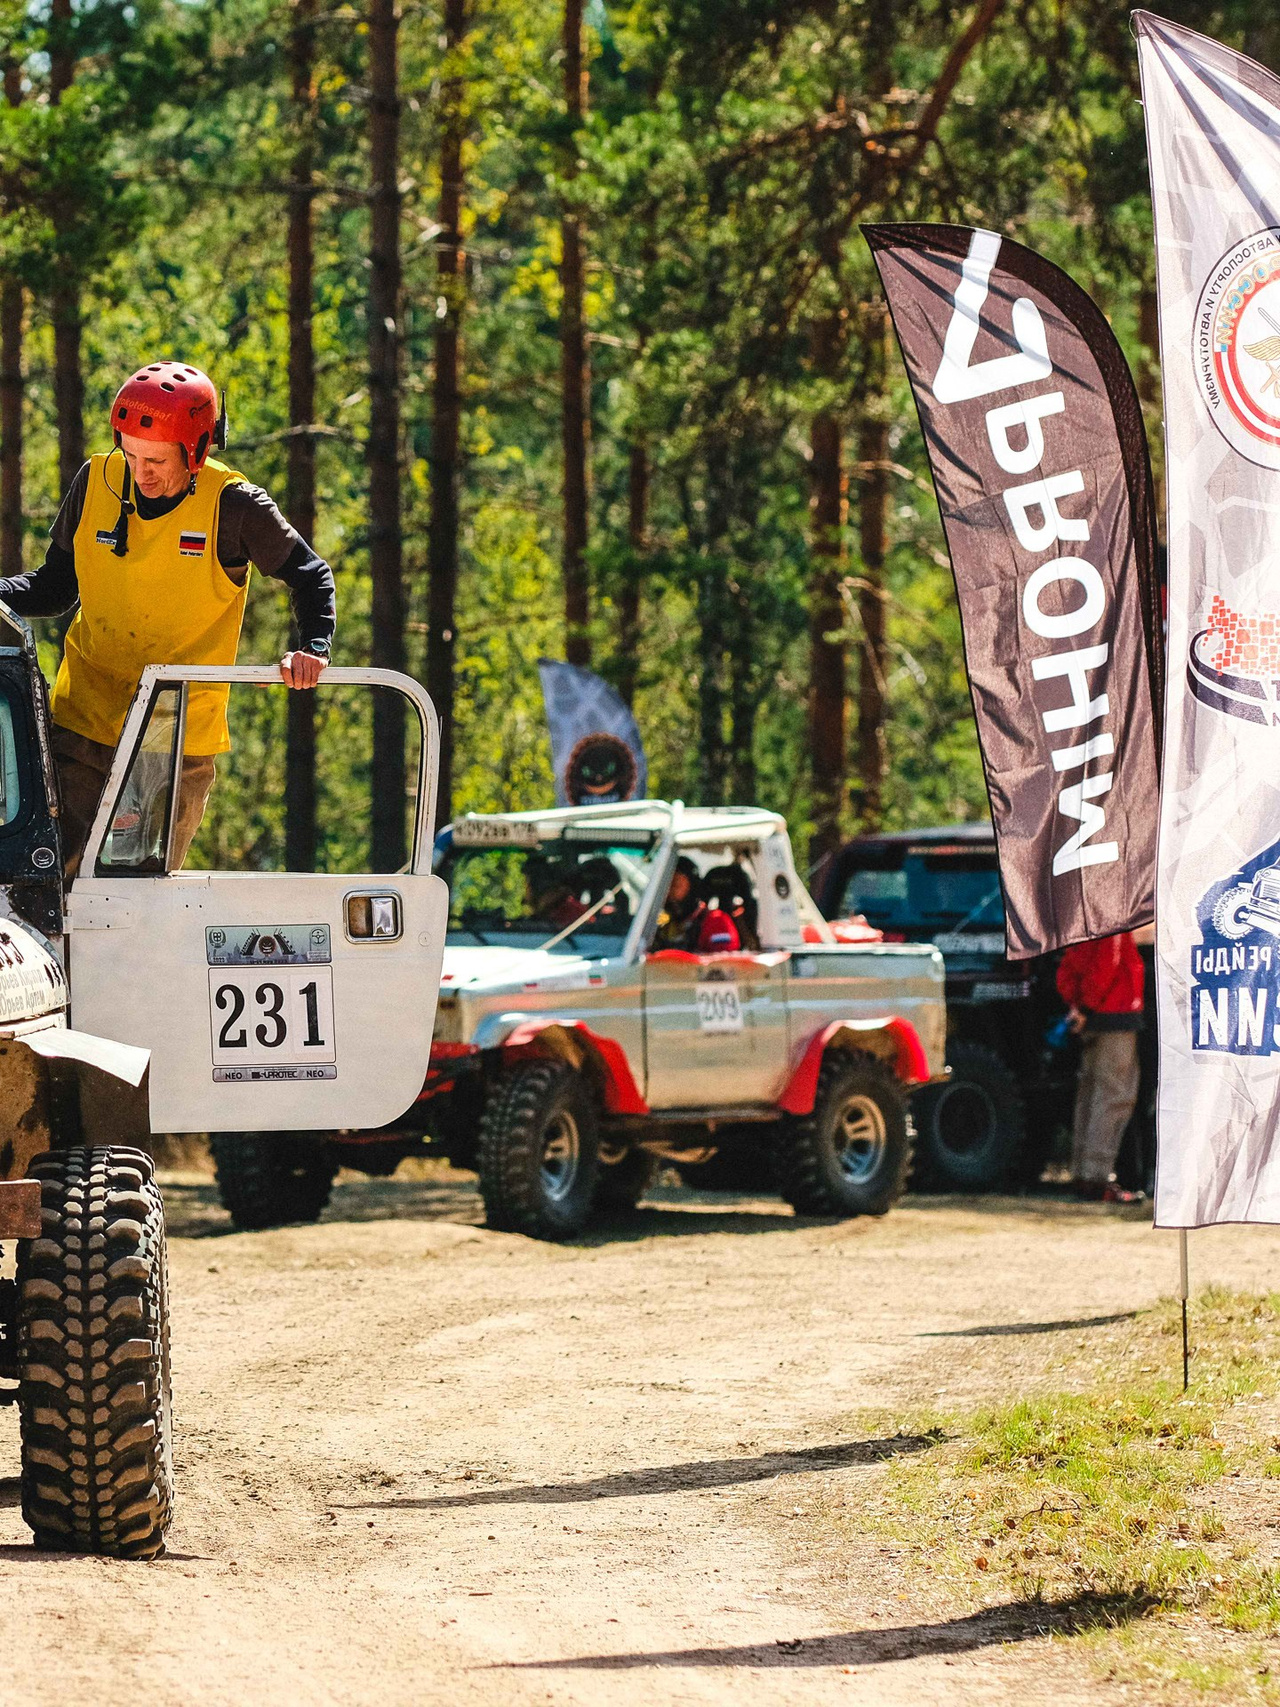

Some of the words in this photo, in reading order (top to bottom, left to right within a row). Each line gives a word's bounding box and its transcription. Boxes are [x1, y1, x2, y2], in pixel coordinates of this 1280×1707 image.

[215, 982, 325, 1048] 231
[225, 1072, 242, 1080] NEO
[306, 1070, 324, 1078] NEO
